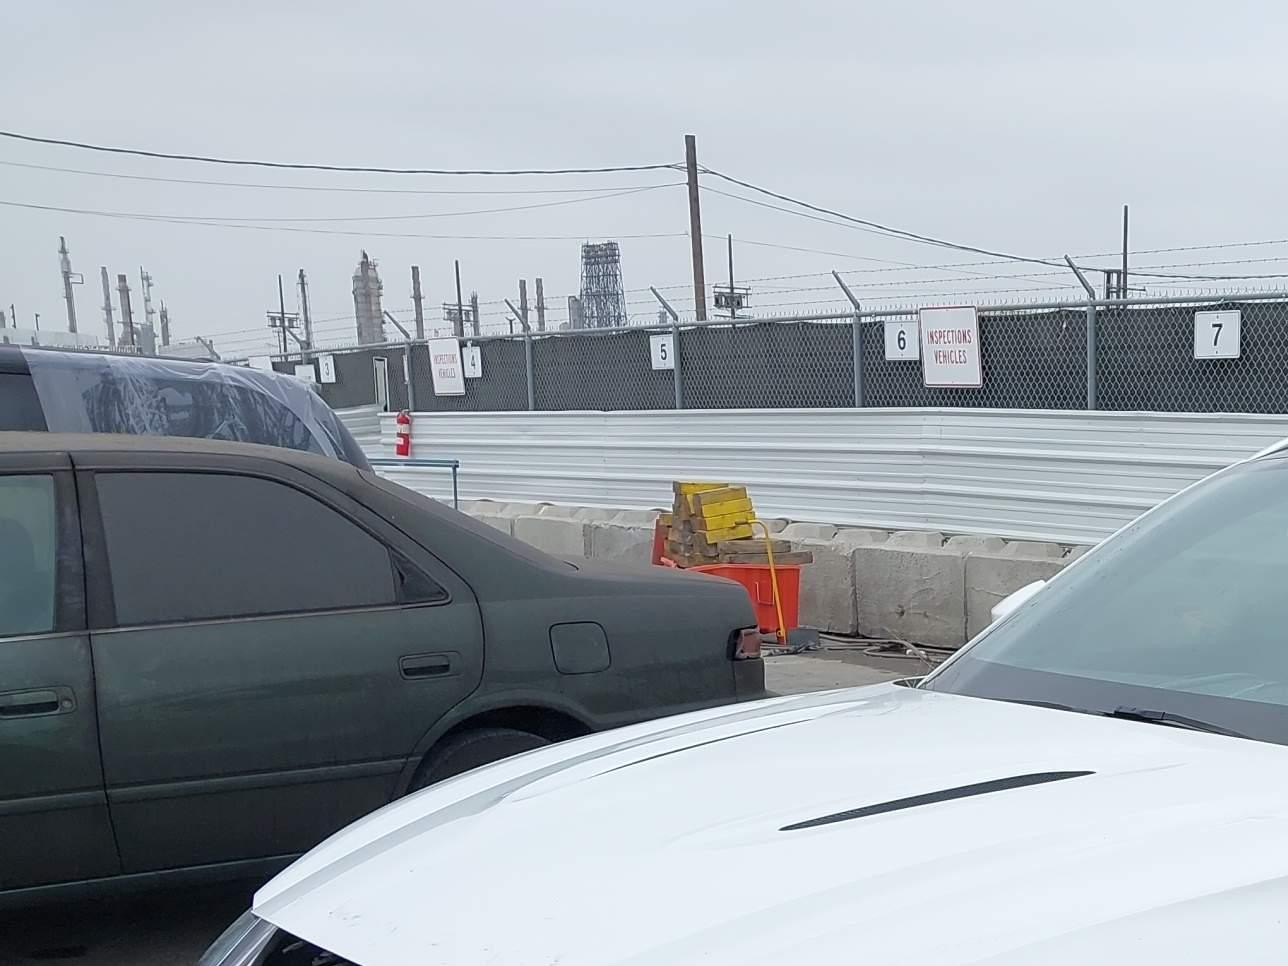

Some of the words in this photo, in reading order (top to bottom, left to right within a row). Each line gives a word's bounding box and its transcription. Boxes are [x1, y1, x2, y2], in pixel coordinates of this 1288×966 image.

[897, 329, 907, 351] 6
[926, 329, 972, 345] INSPECTIONS
[1211, 323, 1223, 347] 7
[660, 343, 668, 361] 5
[933, 349, 967, 365] VEHICLES
[324, 362, 330, 376] 3
[470, 354, 476, 370] 4
